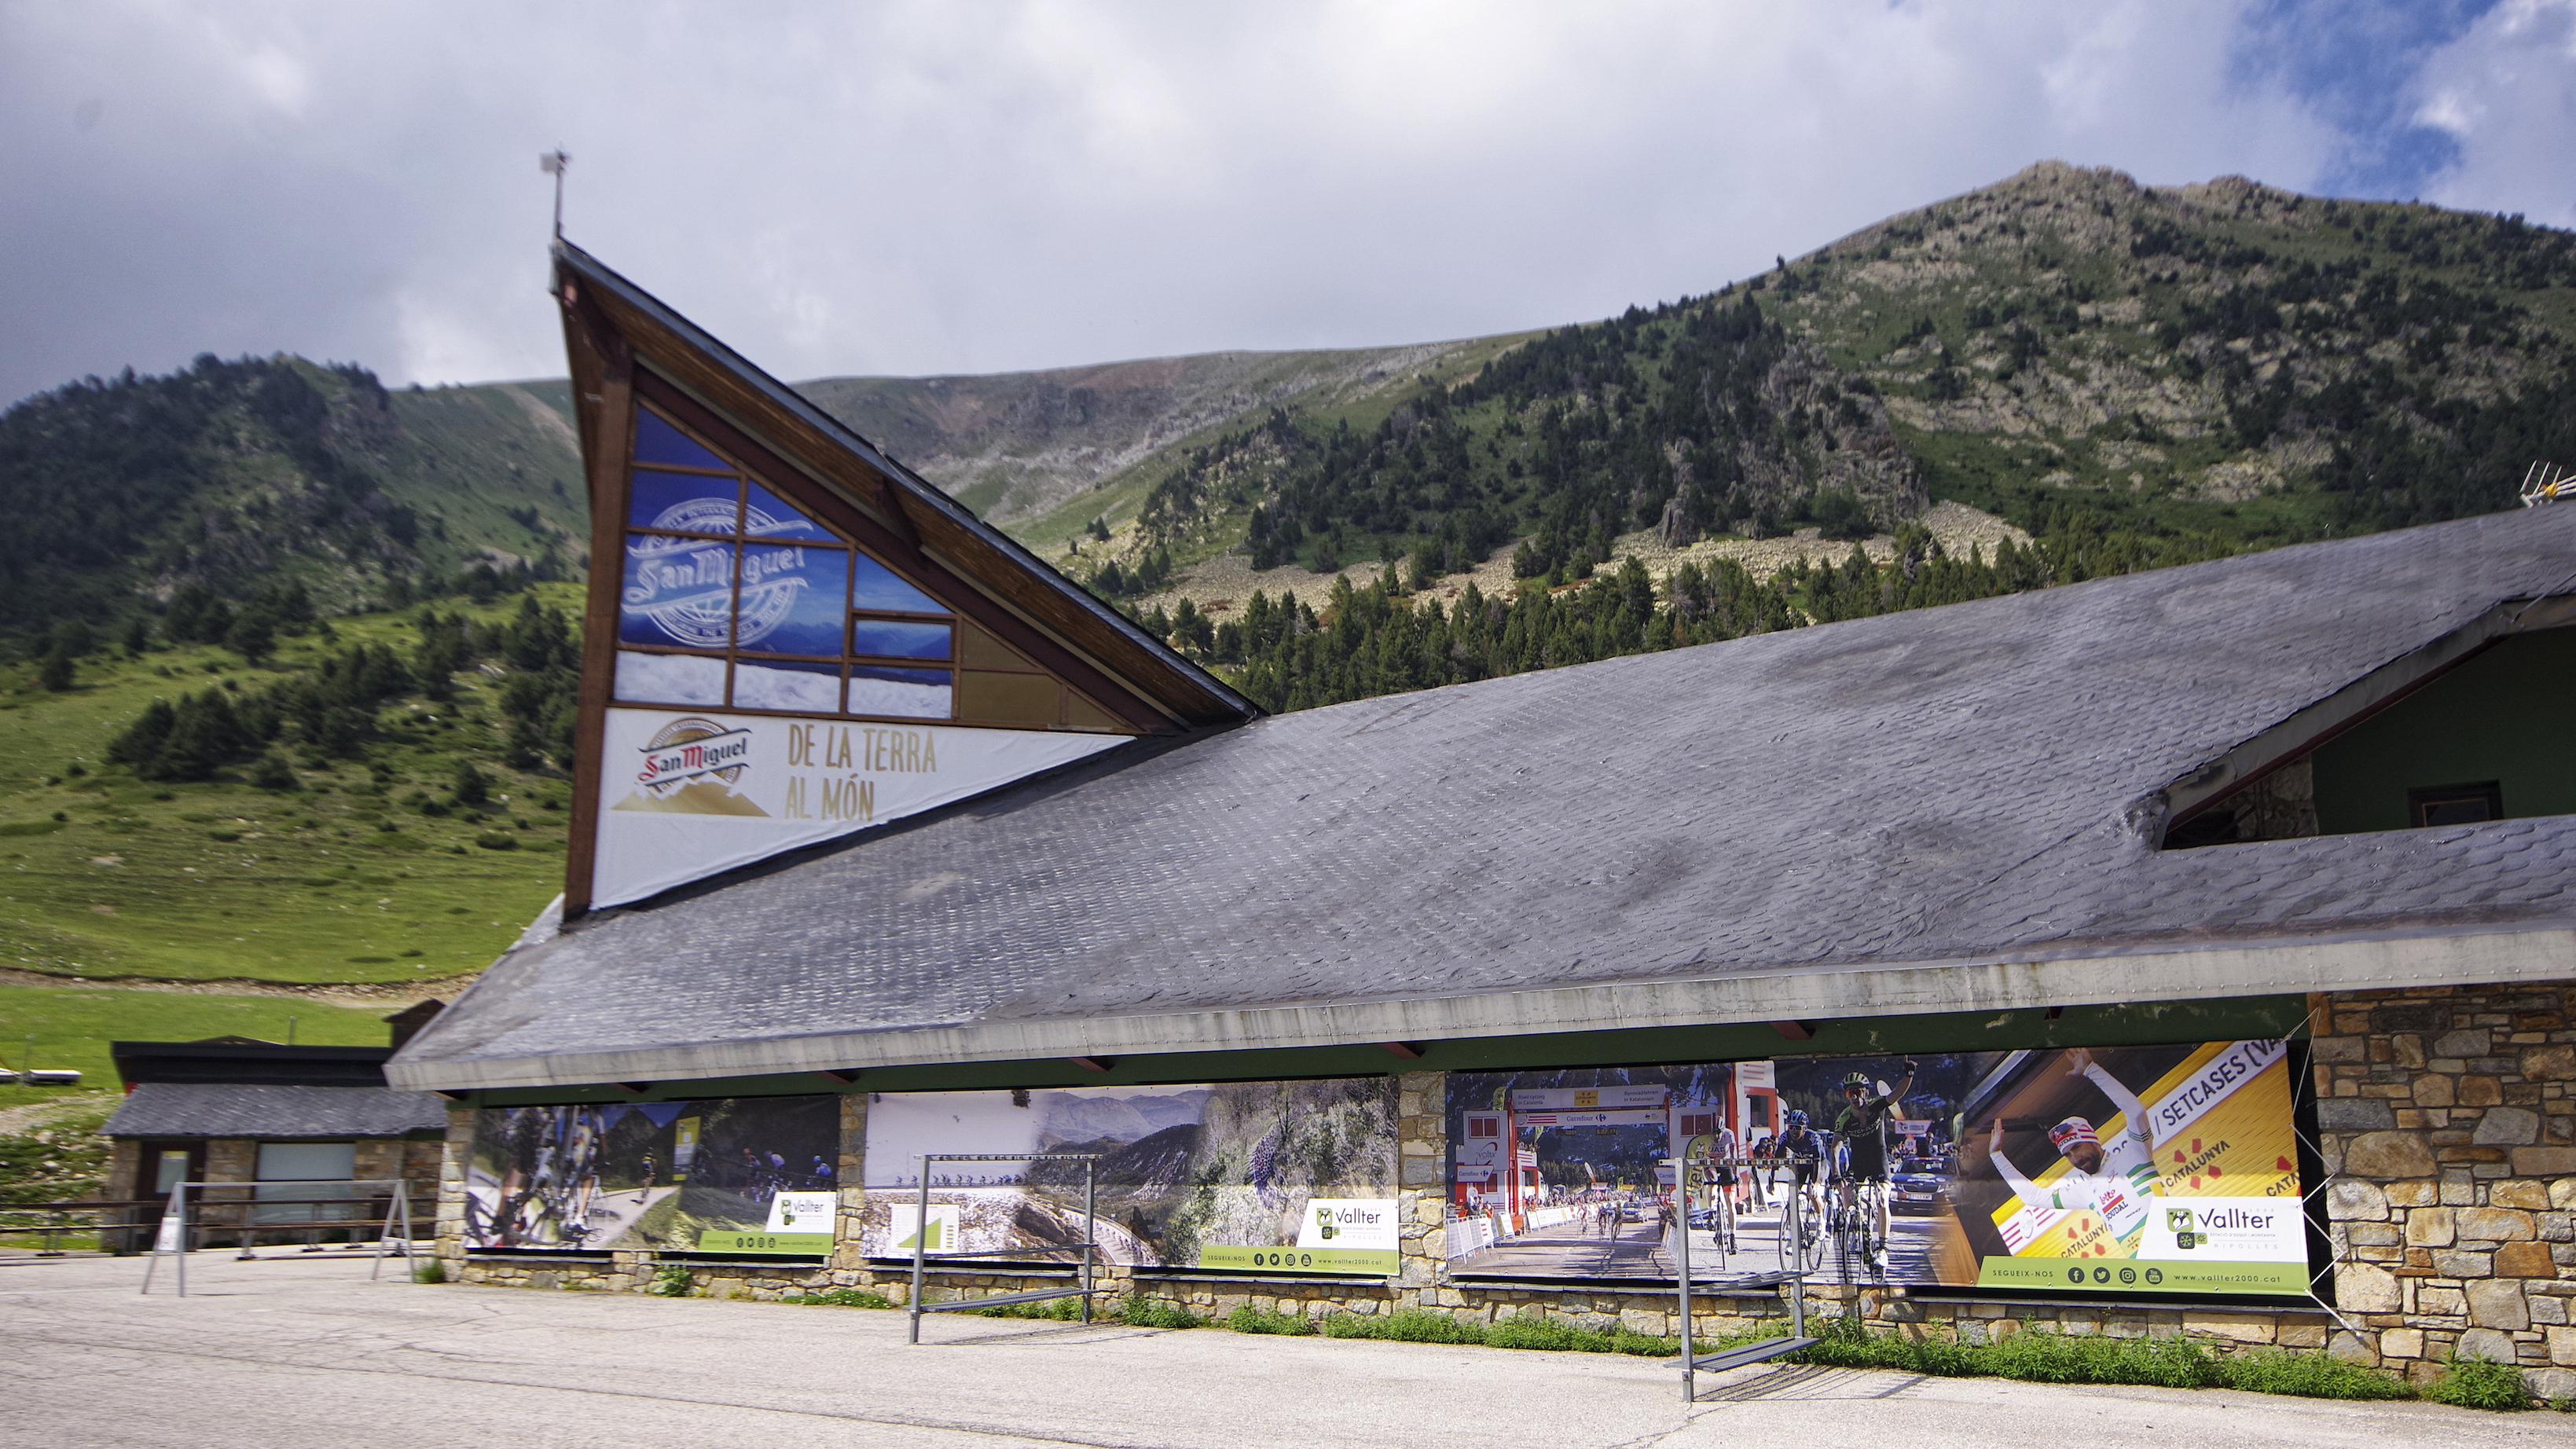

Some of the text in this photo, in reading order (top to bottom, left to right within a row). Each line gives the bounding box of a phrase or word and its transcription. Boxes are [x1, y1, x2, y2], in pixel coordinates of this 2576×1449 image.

[788, 724, 936, 772] DE LA TERRA
[785, 773, 874, 822] AL MÓN
[2162, 1055, 2247, 1127] SETCASES
[2165, 1139, 2231, 1187] CATALUNYA
[2266, 1169, 2300, 1197] CATA
[1335, 1208, 1381, 1224] Vallter
[2105, 1201, 2129, 1221] SOUDAL
[2197, 1208, 2275, 1228] Vallter
[1992, 1269, 2054, 1278] SEGUEIX-NOS
[2174, 1274, 2281, 1283] www.vallter2000.cat
